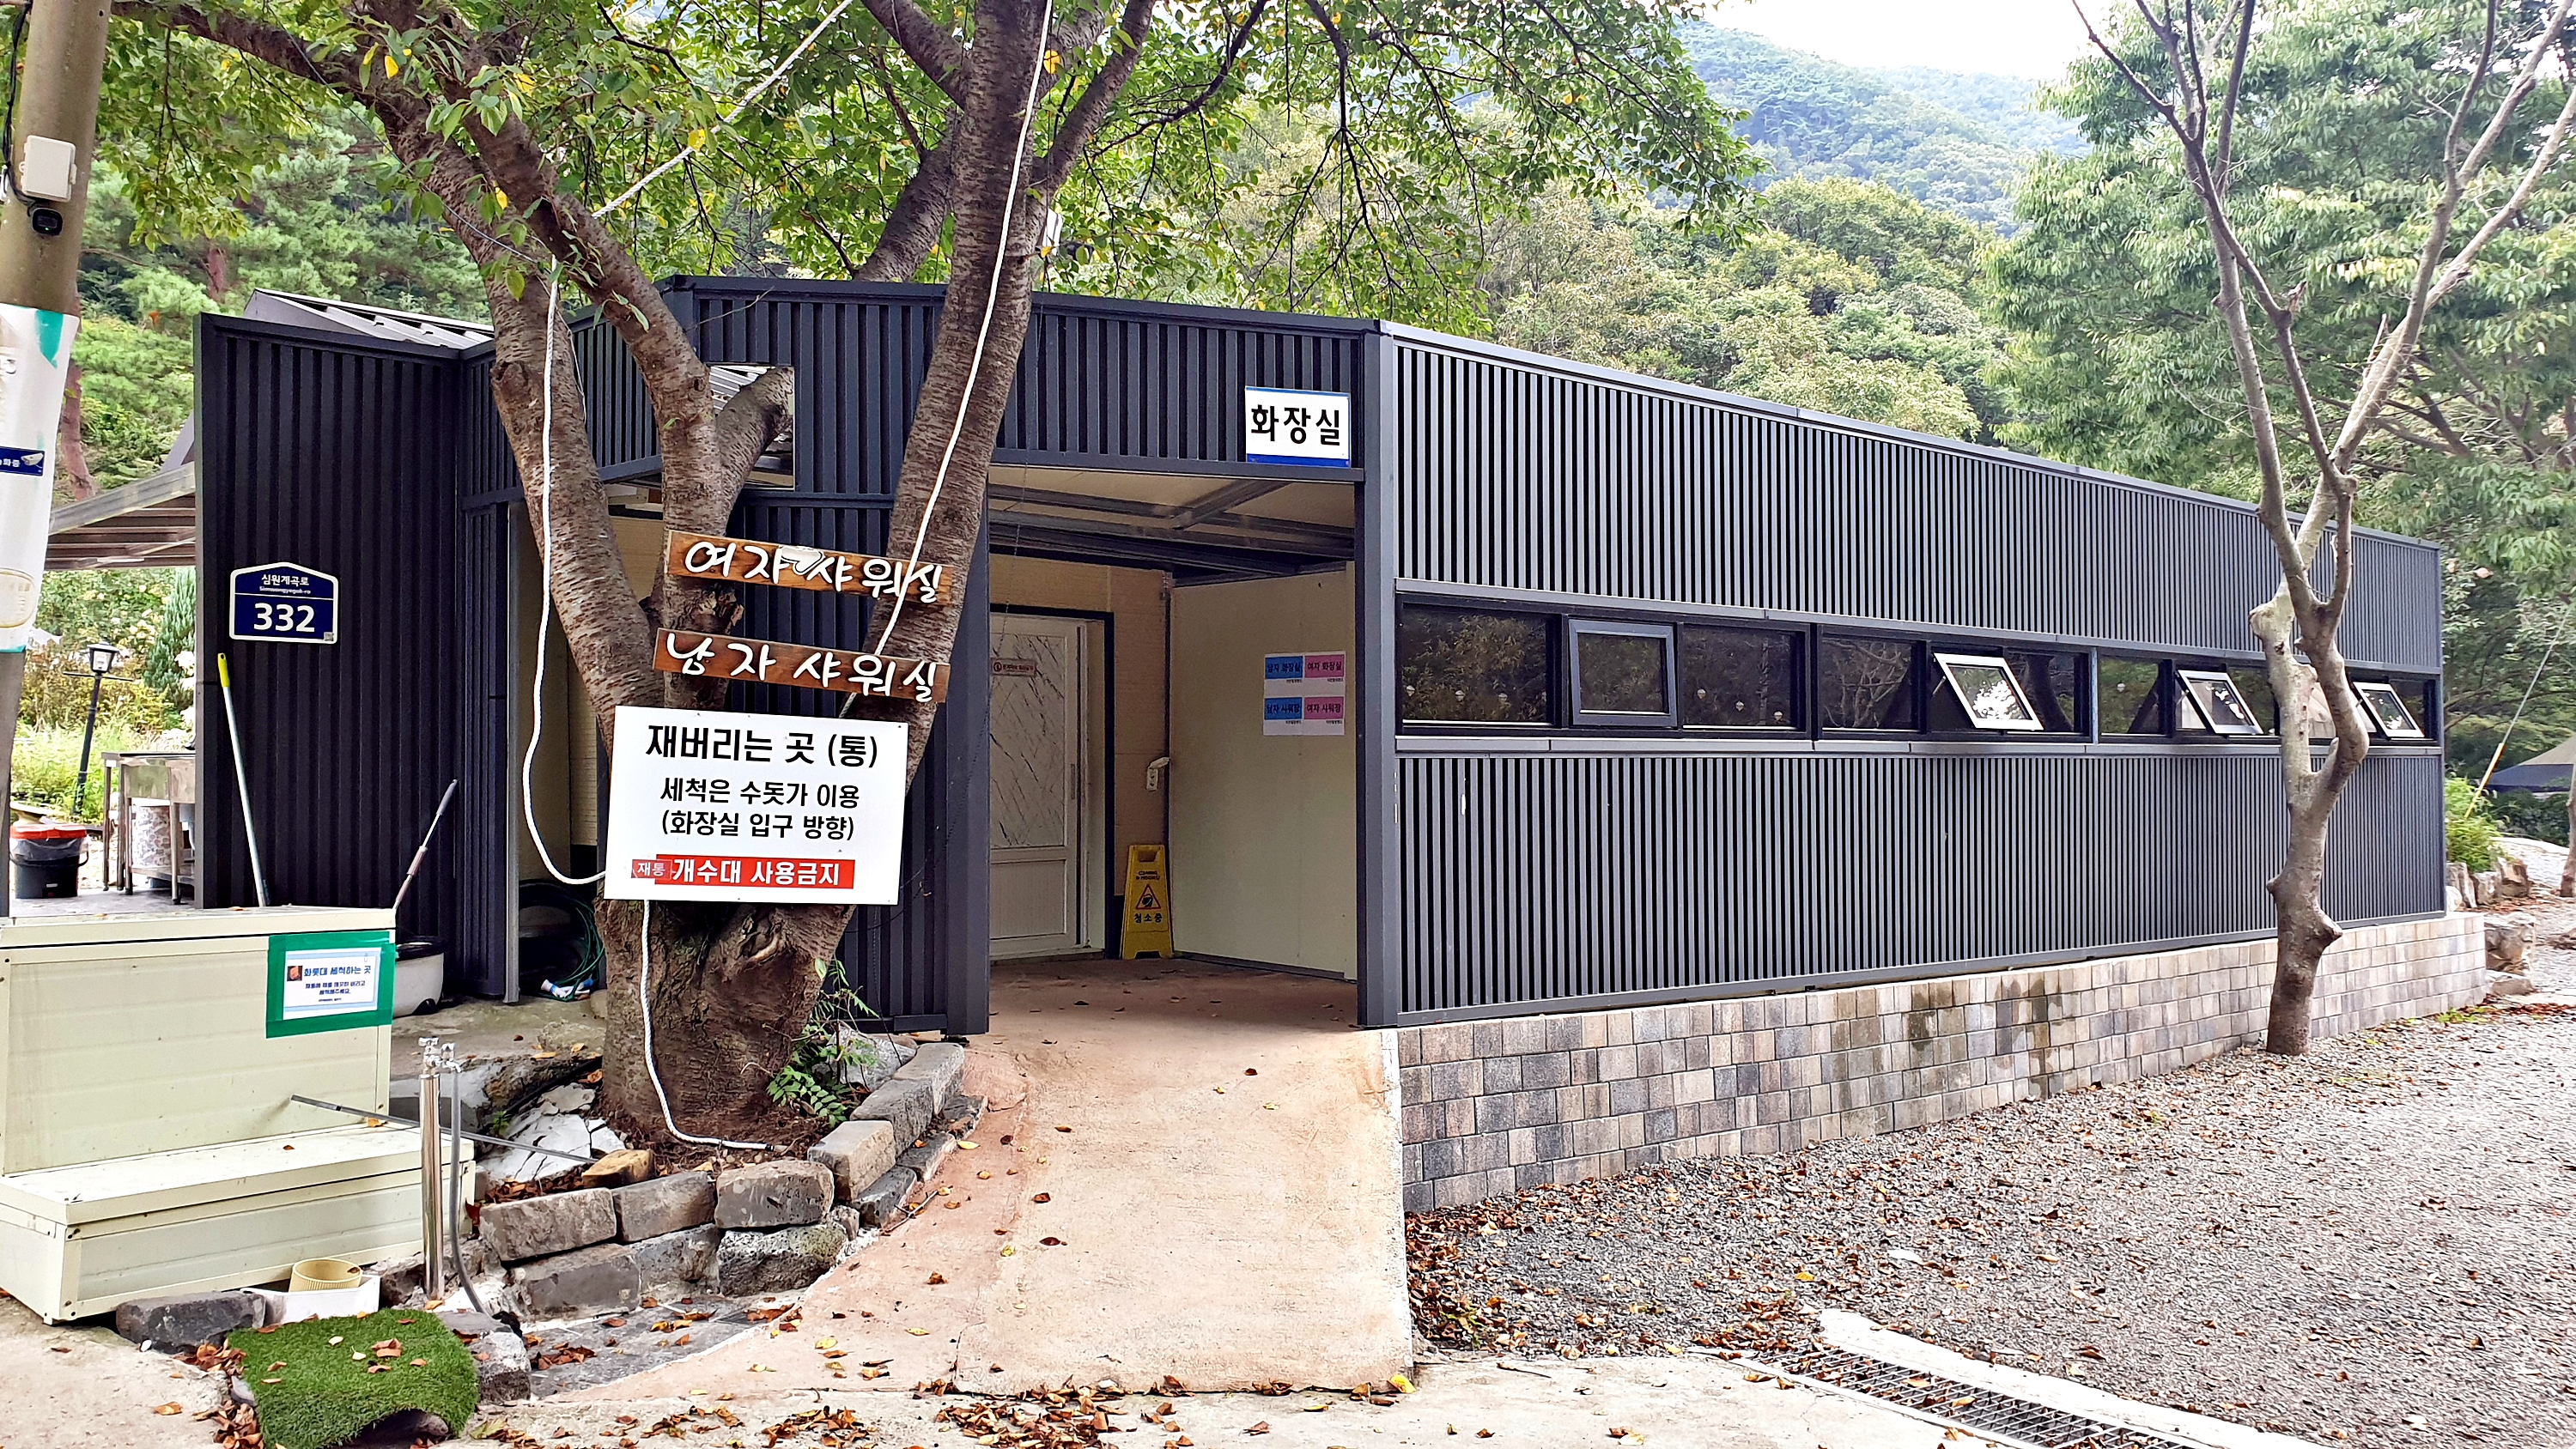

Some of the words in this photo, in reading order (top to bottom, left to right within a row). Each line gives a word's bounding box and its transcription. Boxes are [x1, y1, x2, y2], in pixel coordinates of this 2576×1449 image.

[1251, 404, 1340, 446] 화장실
[261, 573, 310, 587] 심원계곡로
[684, 541, 790, 585] 여자
[806, 555, 943, 604] 샤워실
[253, 602, 315, 633] 332
[665, 632, 777, 682] 남자
[793, 651, 937, 703] 샤워실
[1307, 662, 1320, 671] 여자
[1306, 703, 1320, 713] 여자
[646, 724, 773, 764] 재버리는
[785, 731, 816, 766] 곳
[827, 733, 878, 768] (통)
[659, 777, 732, 804] 세척은
[739, 780, 808, 808] 수돗가
[817, 784, 860, 809] 이용
[661, 809, 739, 838] (화장실
[750, 814, 793, 840] 입구
[803, 815, 854, 841] 방향)
[636, 862, 666, 876] 재통
[671, 858, 741, 884] 개수대
[750, 861, 840, 886] 사용금지
[364, 965, 372, 974] 곳
